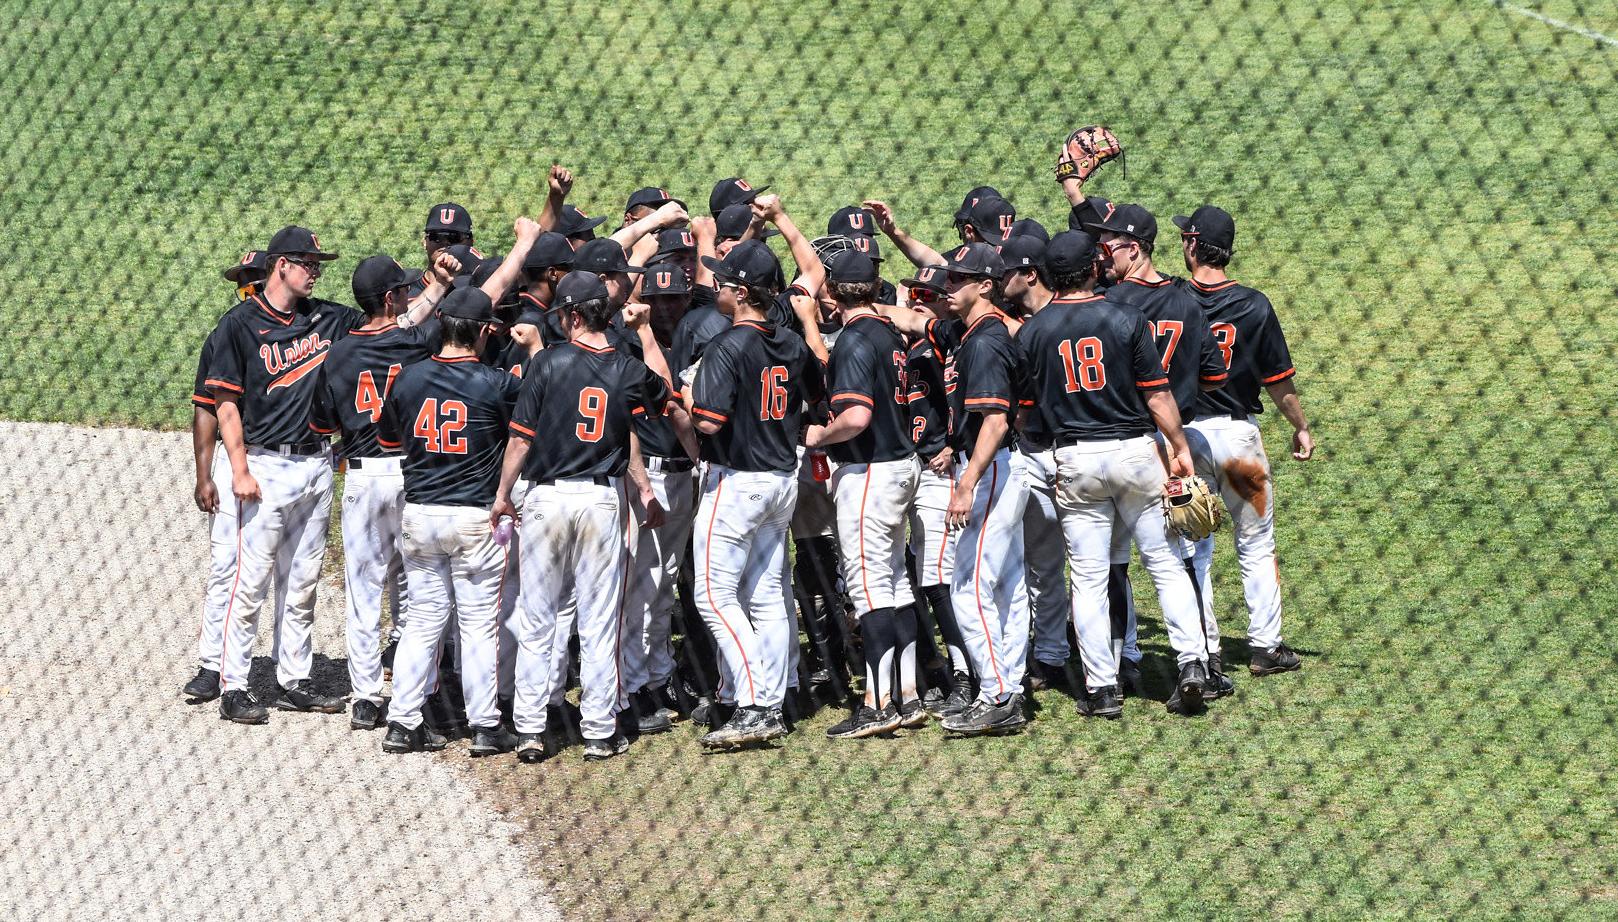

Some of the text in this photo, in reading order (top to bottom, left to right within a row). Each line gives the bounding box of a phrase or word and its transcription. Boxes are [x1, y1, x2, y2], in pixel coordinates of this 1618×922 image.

[440, 208, 455, 225] U
[848, 213, 864, 230] U
[855, 237, 870, 253] U
[656, 271, 672, 289] U
[919, 267, 936, 282] U
[259, 331, 332, 375] Union
[1058, 336, 1107, 394] 18
[1148, 320, 1184, 374] 7
[575, 386, 609, 443] 9
[760, 365, 789, 422] 16
[413, 397, 468, 454] 42
